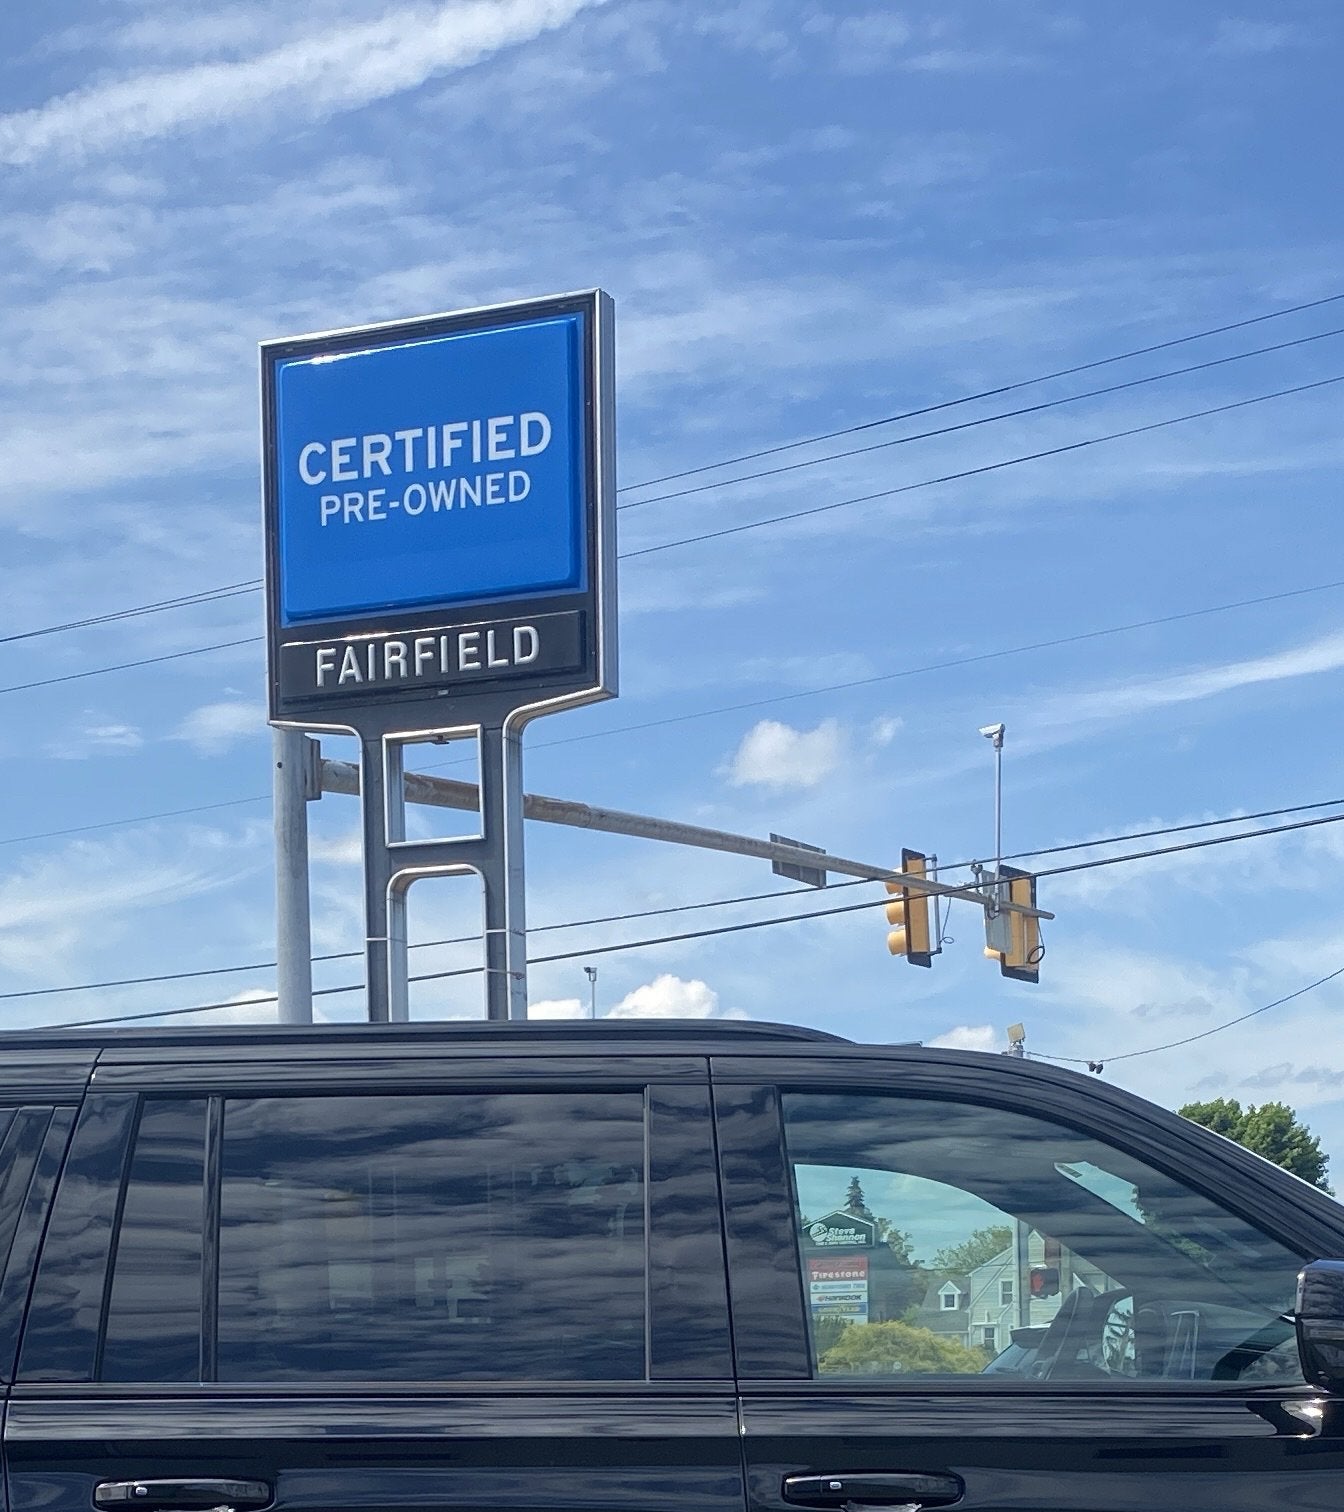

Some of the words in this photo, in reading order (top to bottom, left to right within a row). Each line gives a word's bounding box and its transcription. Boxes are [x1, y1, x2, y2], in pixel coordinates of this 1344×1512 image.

[298, 411, 552, 485] CERTIFIED
[320, 470, 531, 527] PRE-OWNED
[315, 625, 540, 688] FAIRFIELD
[825, 1233, 866, 1242] Shannon
